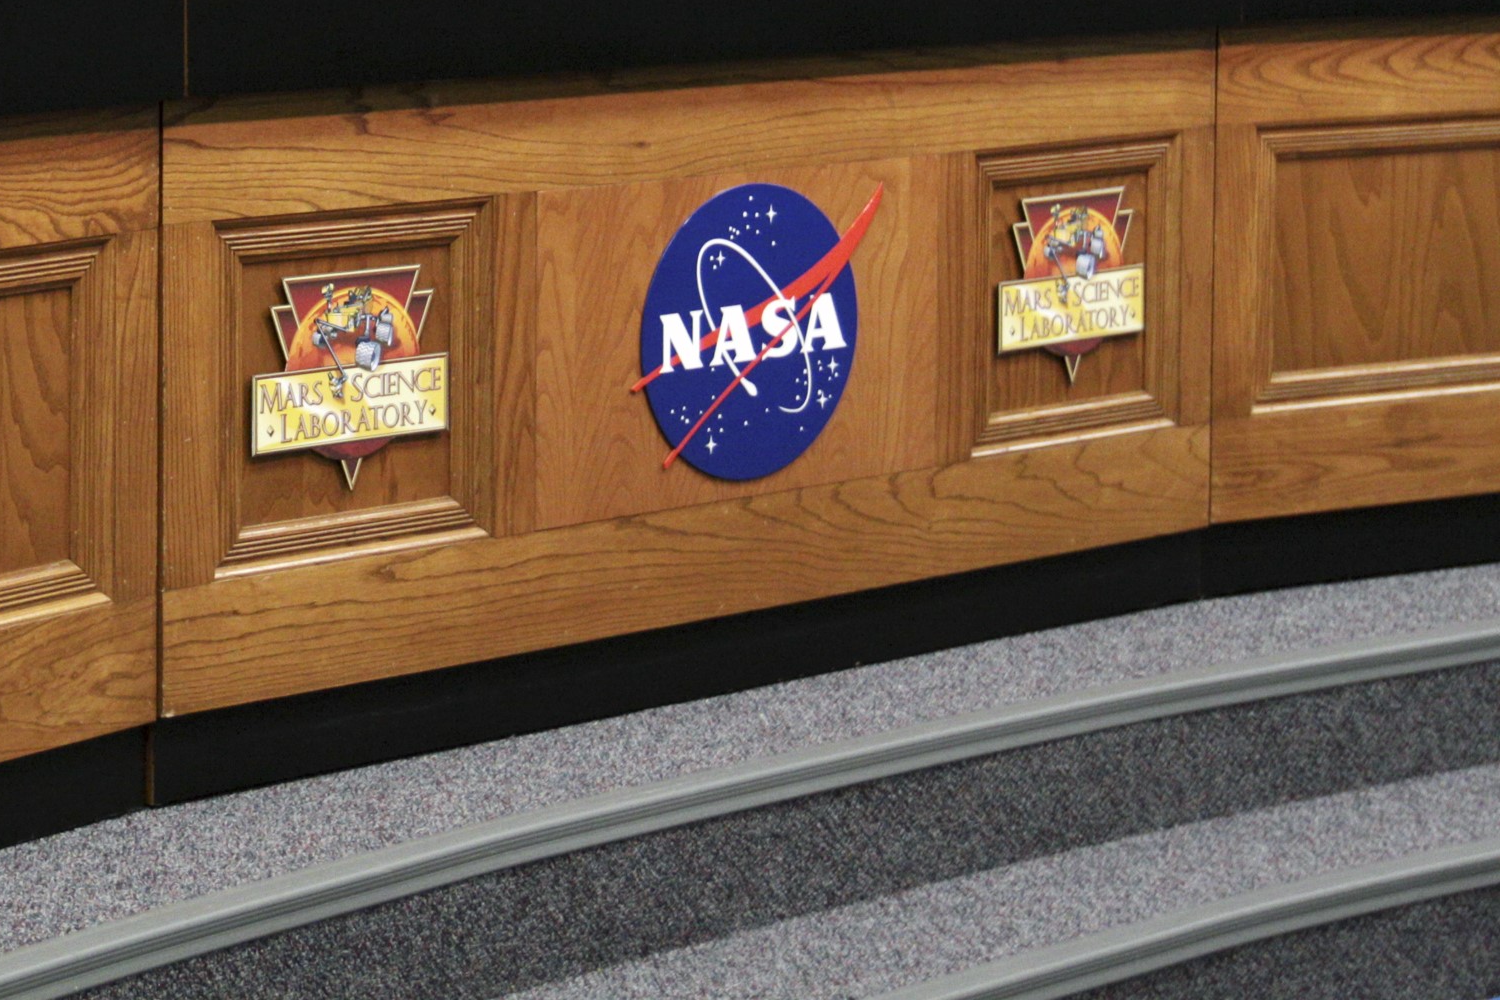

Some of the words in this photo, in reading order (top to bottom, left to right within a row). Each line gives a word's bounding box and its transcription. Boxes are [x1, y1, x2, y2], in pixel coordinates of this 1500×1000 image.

[1004, 289, 1051, 316] MARS
[1073, 276, 1139, 307] SCIENCE
[659, 293, 847, 374] NASA
[1020, 304, 1129, 342] LABORATORY
[260, 381, 323, 414] MARS
[350, 367, 441, 401] SCIENCE
[280, 400, 427, 443] LABORATORY
